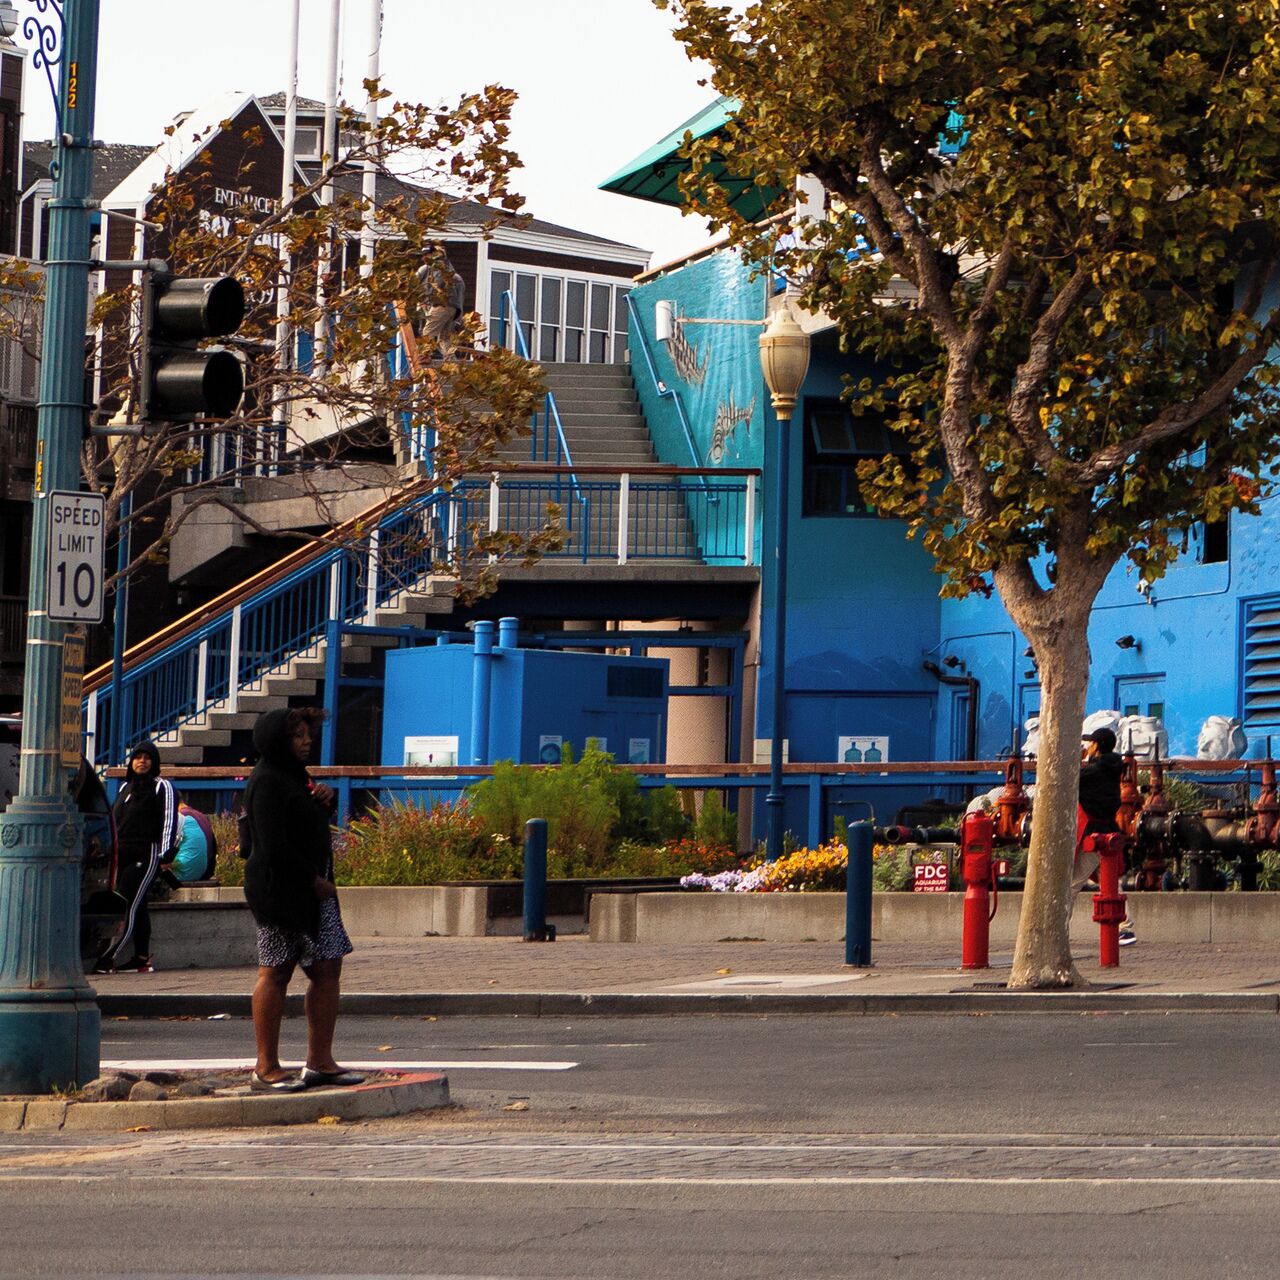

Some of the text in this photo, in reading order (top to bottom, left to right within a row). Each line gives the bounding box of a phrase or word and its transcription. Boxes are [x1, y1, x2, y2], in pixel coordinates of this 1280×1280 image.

[67, 63, 77, 108] 122
[54, 505, 101, 527] SPEED
[58, 533, 95, 554] LIMIT
[57, 561, 95, 608] 10
[915, 865, 947, 879] FDC
[914, 879, 947, 887] AQUARIUM
